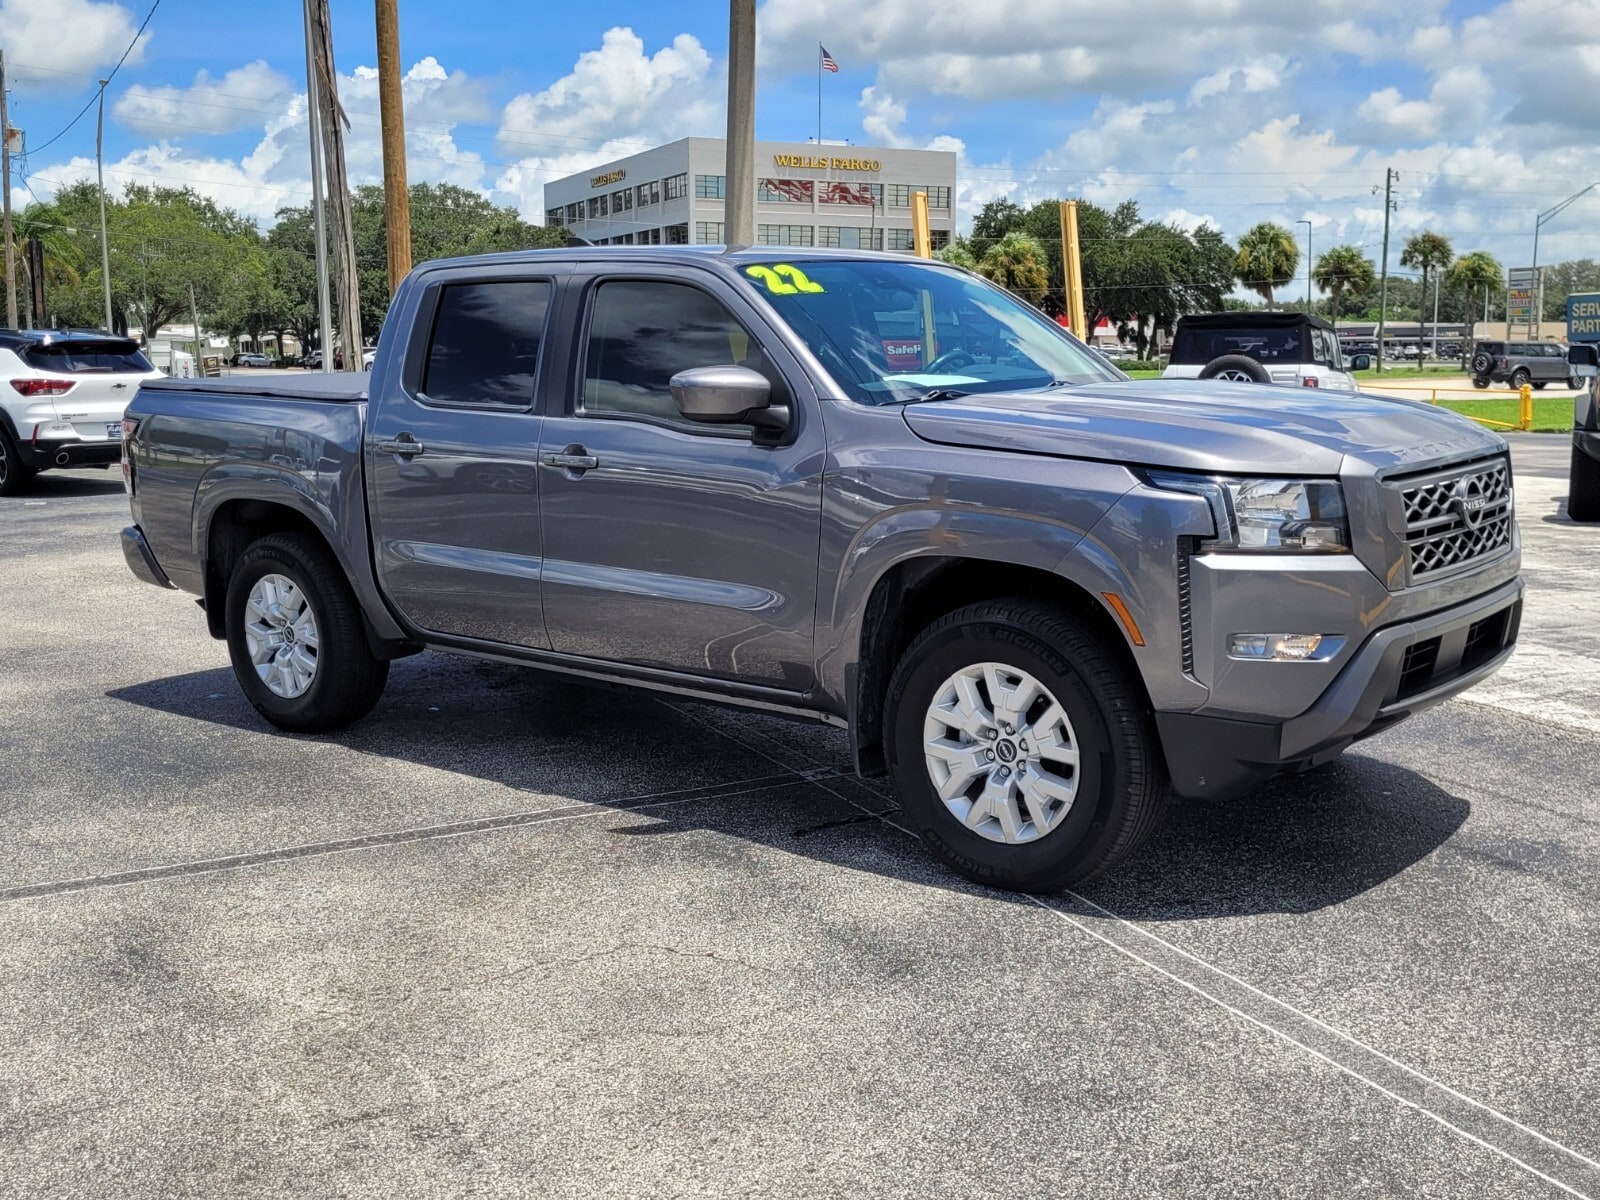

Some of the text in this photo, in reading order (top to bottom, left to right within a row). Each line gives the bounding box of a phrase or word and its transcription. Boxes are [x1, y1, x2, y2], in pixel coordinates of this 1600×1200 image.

[775, 154, 882, 171] WELLS FARGO
[746, 264, 825, 294] 22
[995, 631, 1066, 674] MICHELIN
